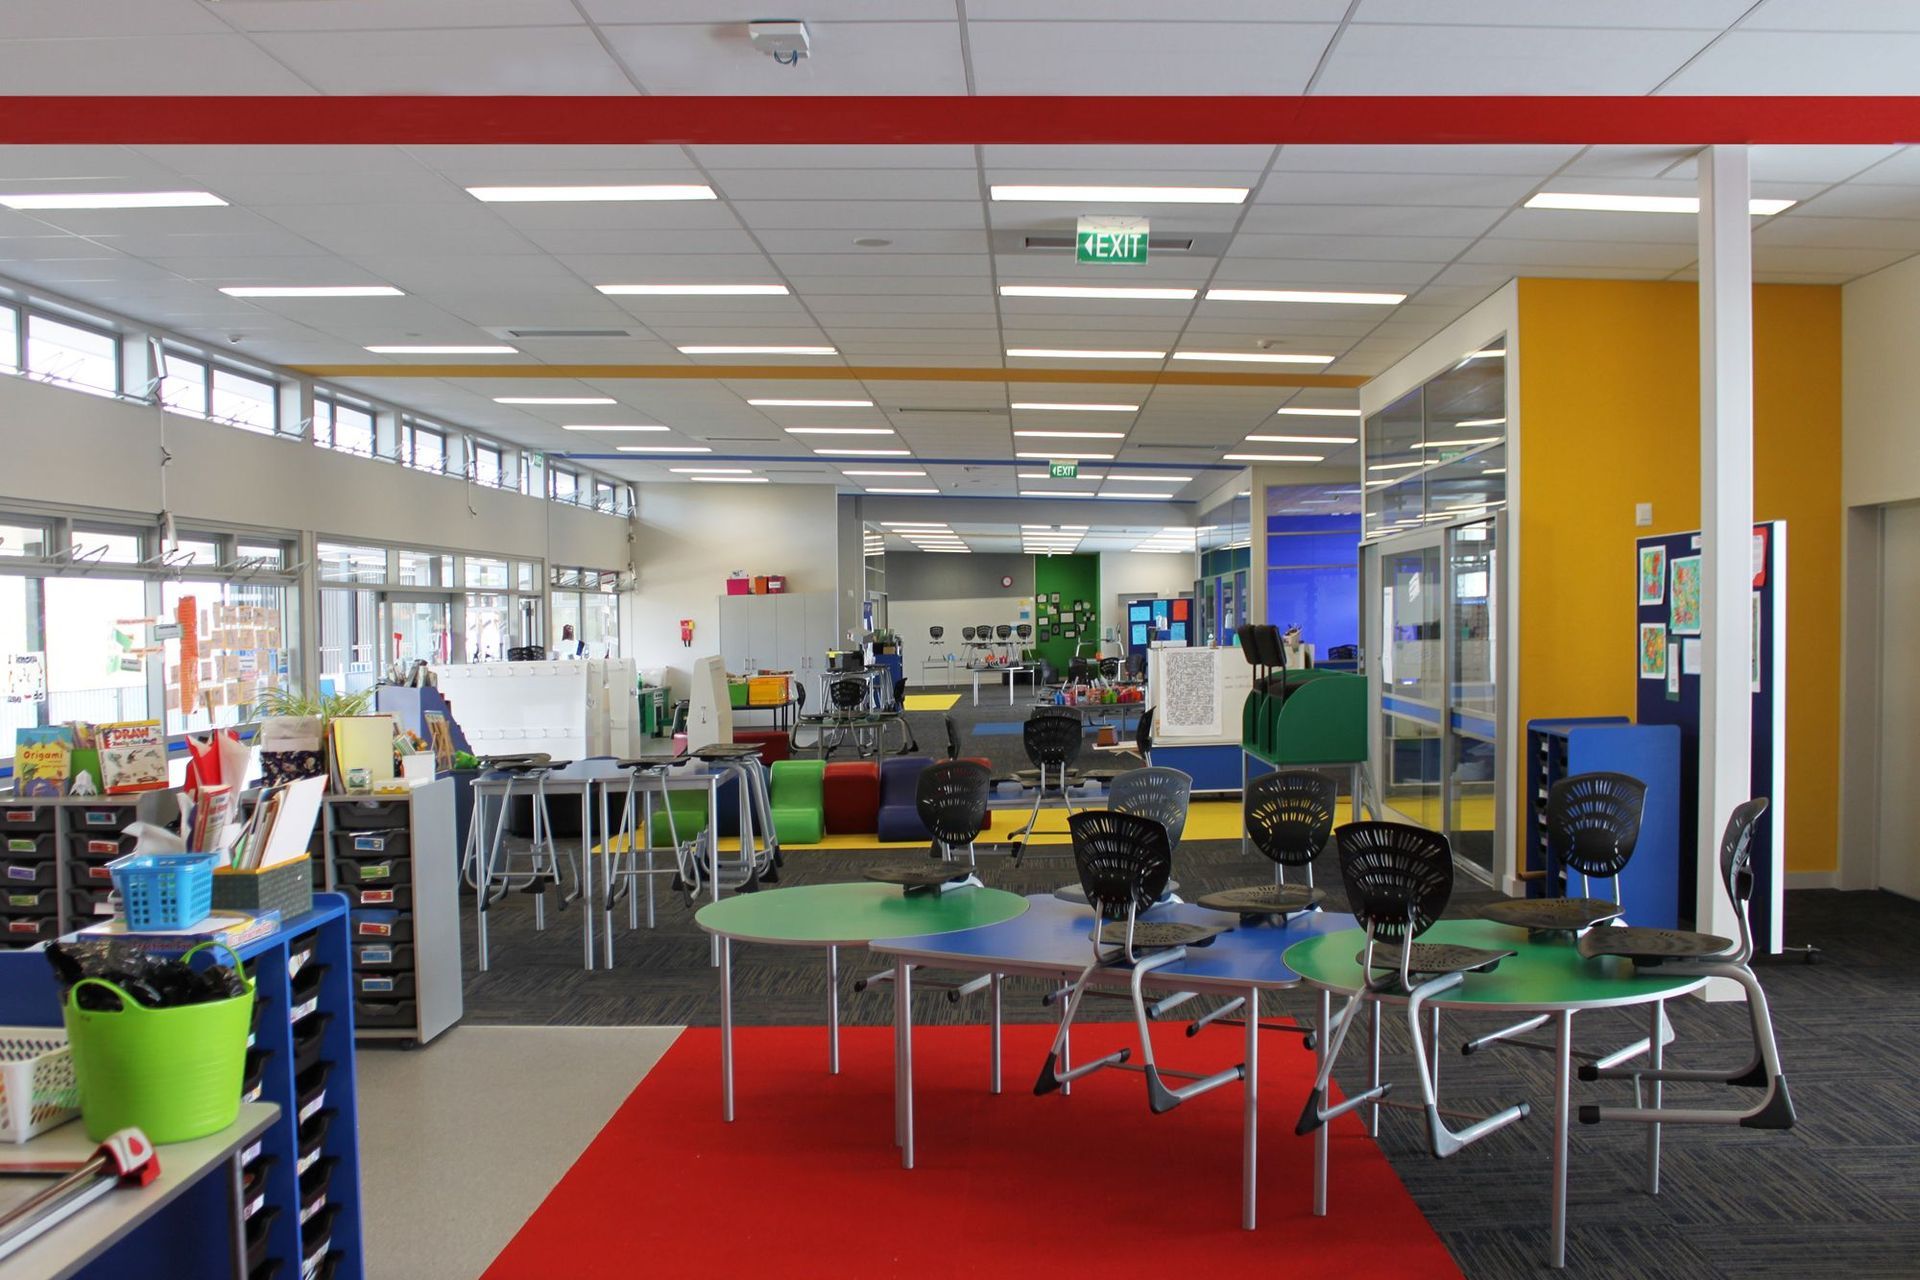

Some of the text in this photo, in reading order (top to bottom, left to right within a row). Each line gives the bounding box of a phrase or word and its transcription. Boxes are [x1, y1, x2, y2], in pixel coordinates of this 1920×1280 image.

[1096, 234, 1141, 258] EXIT
[1057, 466, 1075, 476] EXIT
[113, 727, 149, 740] DRAW
[23, 751, 63, 761] Origami
